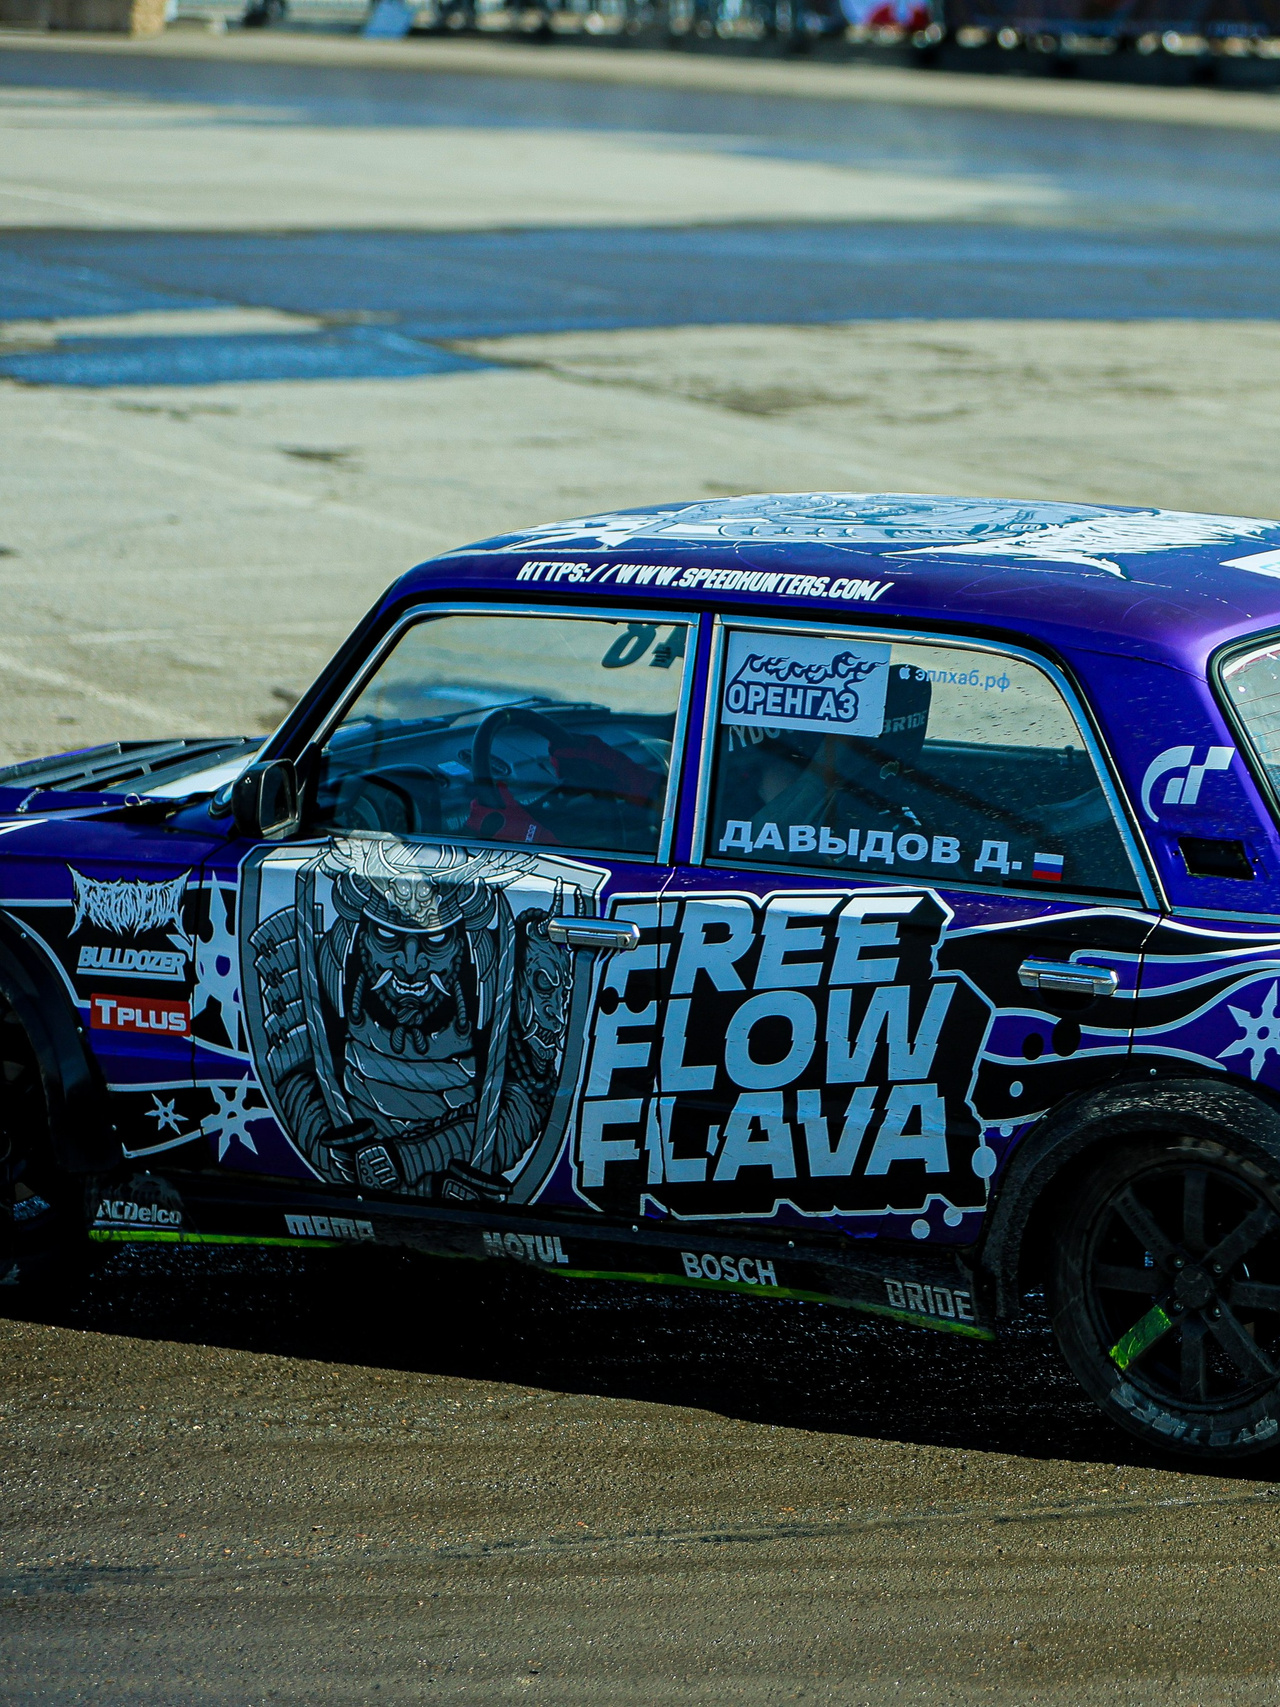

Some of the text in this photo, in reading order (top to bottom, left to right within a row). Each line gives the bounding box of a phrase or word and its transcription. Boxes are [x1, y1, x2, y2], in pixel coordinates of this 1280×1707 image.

[516, 561, 894, 602] HTTPS://WWW.SPEEDHUNTERS.COM/
[728, 683, 858, 722] ОРЕНГАЗ
[718, 820, 1023, 875] ДАВЫДОВ Д.
[77, 945, 186, 974] BULLDOZER
[601, 896, 925, 999] FREE
[584, 982, 957, 1097] FLOW
[577, 1082, 950, 1188] FLAVA
[483, 1231, 569, 1264] MOTUL
[680, 1251, 778, 1287] BOSCH
[883, 1277, 975, 1322] BRIDE
